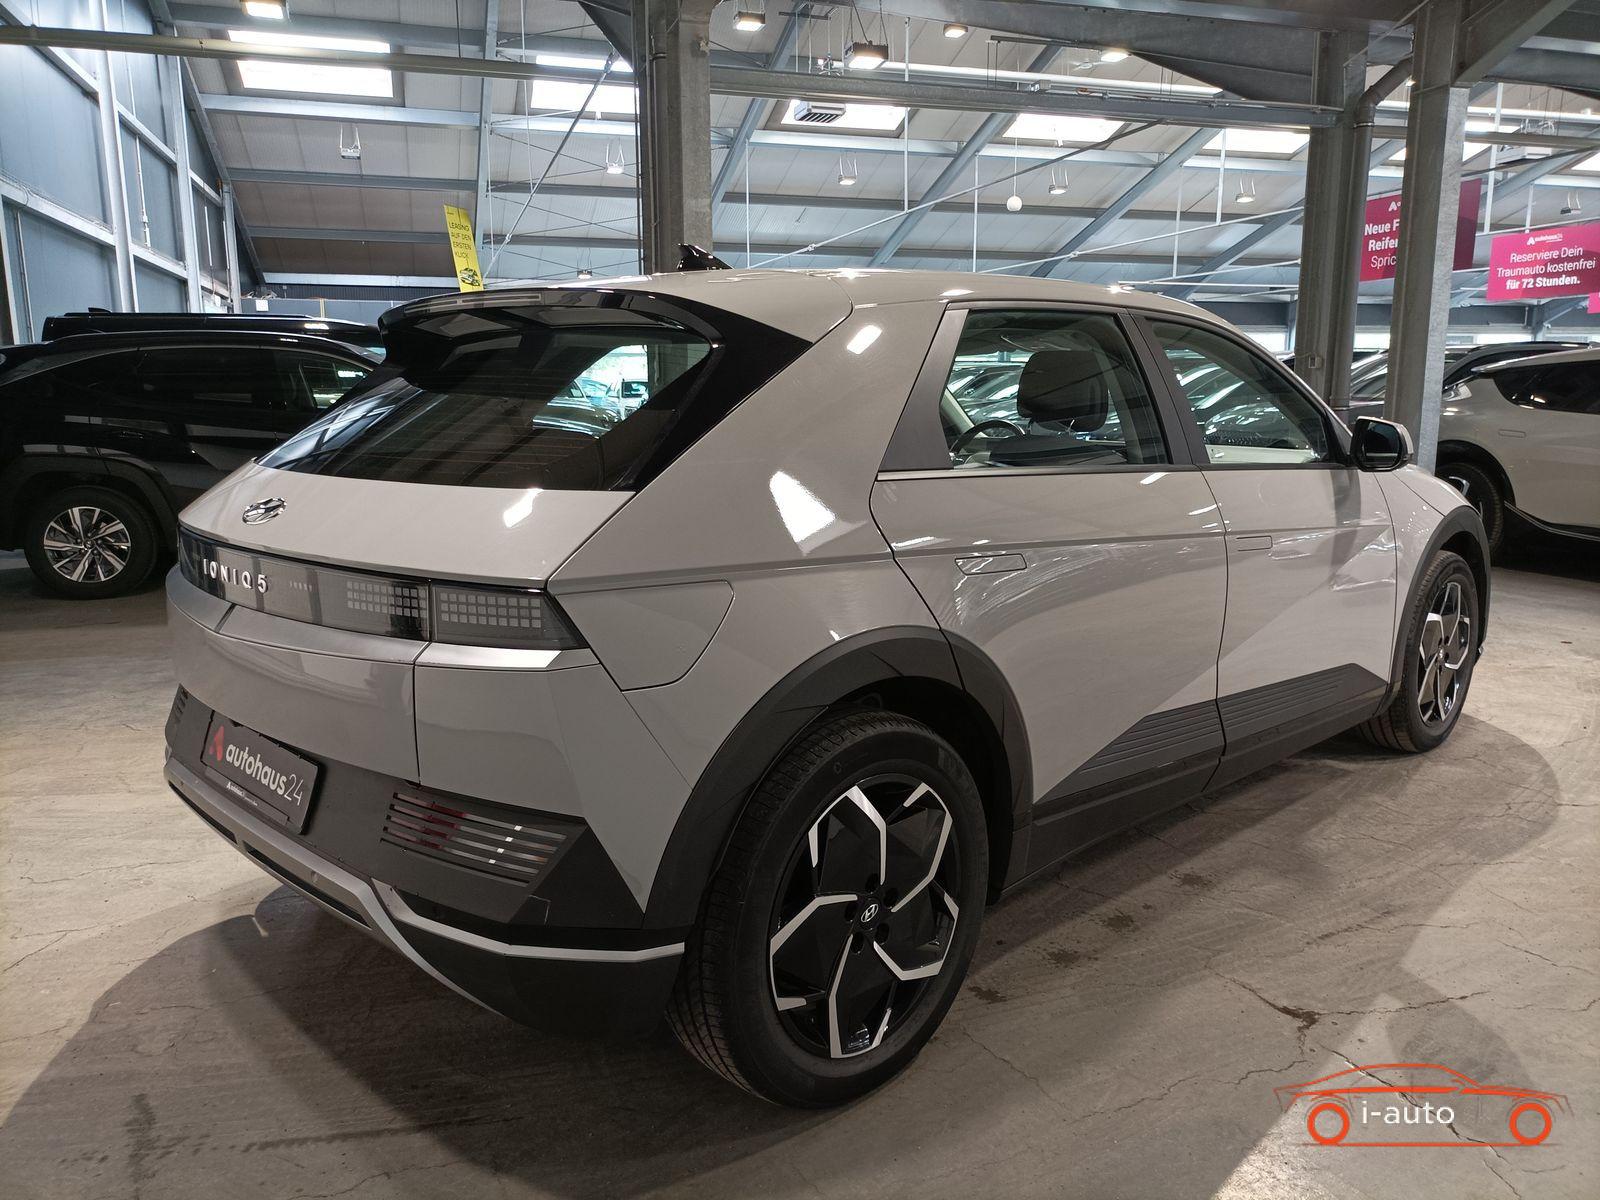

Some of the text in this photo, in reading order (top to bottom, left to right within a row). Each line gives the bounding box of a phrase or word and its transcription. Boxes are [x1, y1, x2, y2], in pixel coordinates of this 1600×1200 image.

[1364, 223, 1391, 236] Neue
[1510, 245, 1583, 263] Reserviere Dein
[1497, 257, 1596, 277] Traumauto kostenfrei
[1506, 274, 1580, 290] für 72 Stunden.
[203, 558, 252, 589] IONIQ
[257, 573, 268, 594] 5
